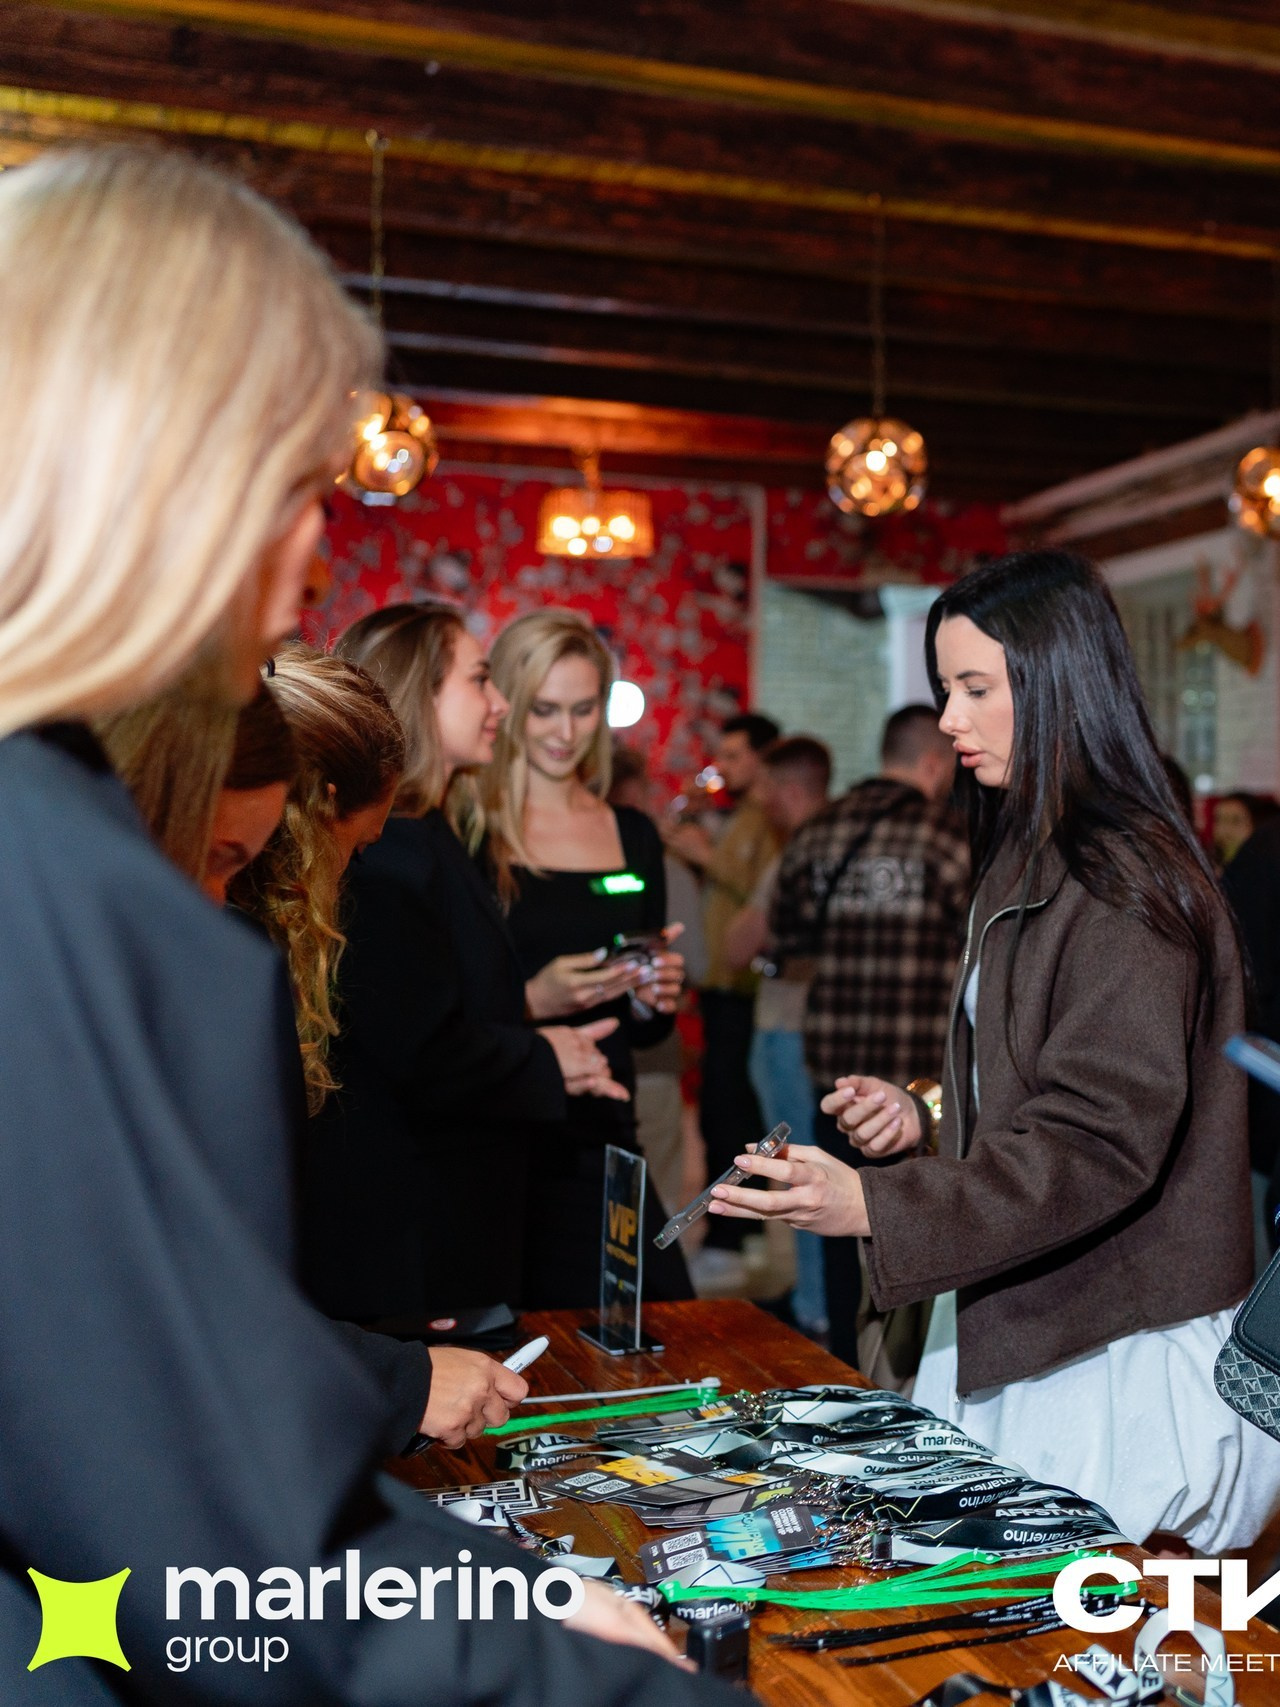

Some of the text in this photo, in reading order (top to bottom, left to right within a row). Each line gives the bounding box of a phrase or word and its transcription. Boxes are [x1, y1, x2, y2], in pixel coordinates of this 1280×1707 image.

[923, 1433, 986, 1452] marlerino
[995, 1507, 1101, 1518] AFFSTYLE
[1003, 1529, 1077, 1545] marlerino
[677, 1600, 756, 1620] marlerino
